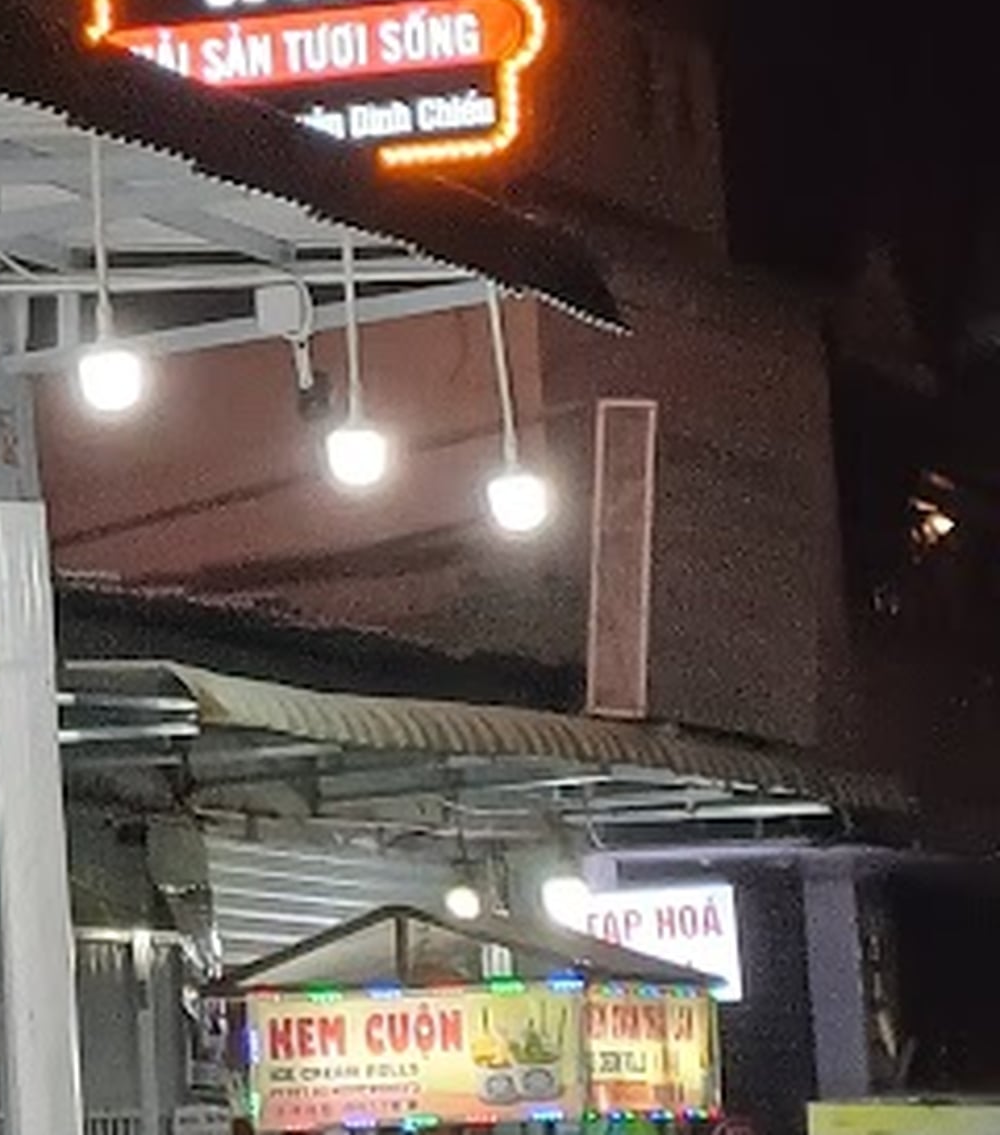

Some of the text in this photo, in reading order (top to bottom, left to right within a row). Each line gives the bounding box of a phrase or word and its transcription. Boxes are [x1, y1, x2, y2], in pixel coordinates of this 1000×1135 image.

[201, 21, 272, 83] SẢN
[283, 22, 368, 74] TƯƠI
[379, 7, 480, 64] SỐNG
[365, 1002, 463, 1060] CUỘN
